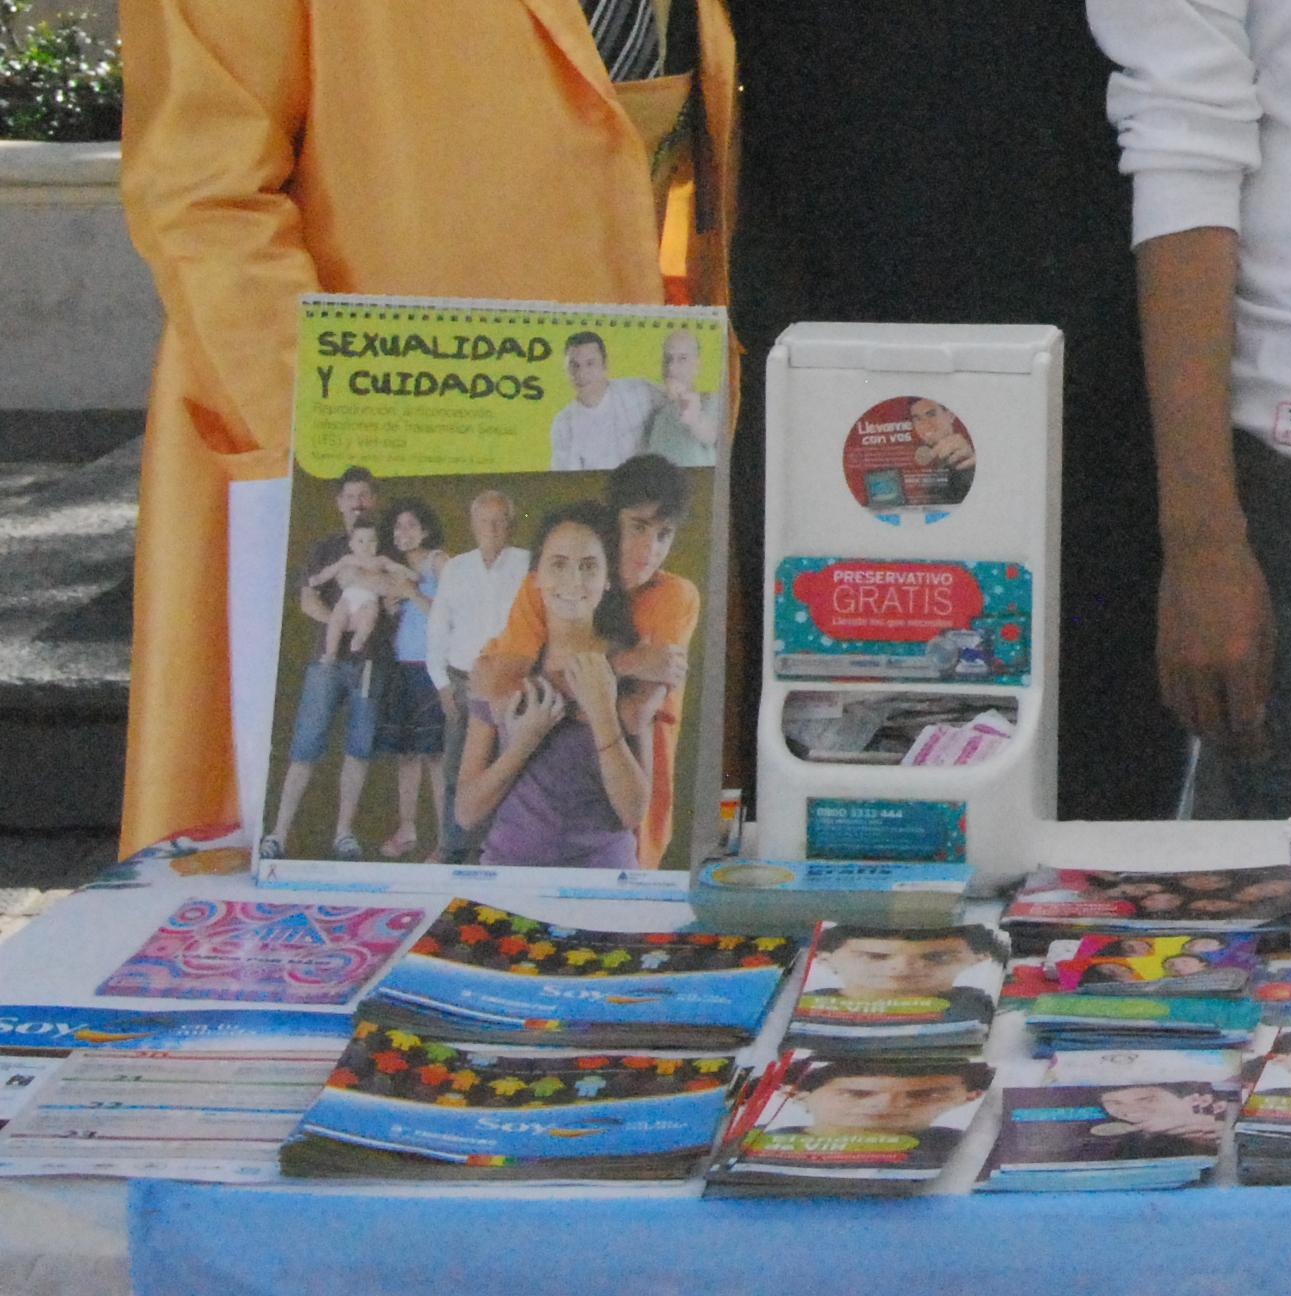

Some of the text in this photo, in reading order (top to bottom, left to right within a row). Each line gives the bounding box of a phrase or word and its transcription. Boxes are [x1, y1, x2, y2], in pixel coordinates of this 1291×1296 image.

[317, 330, 553, 363] SEXUALIDAD
[316, 364, 545, 401] Y CUIDADOS
[833, 570, 953, 585] PRESERVATIVO
[833, 585, 953, 616] GRATIS
